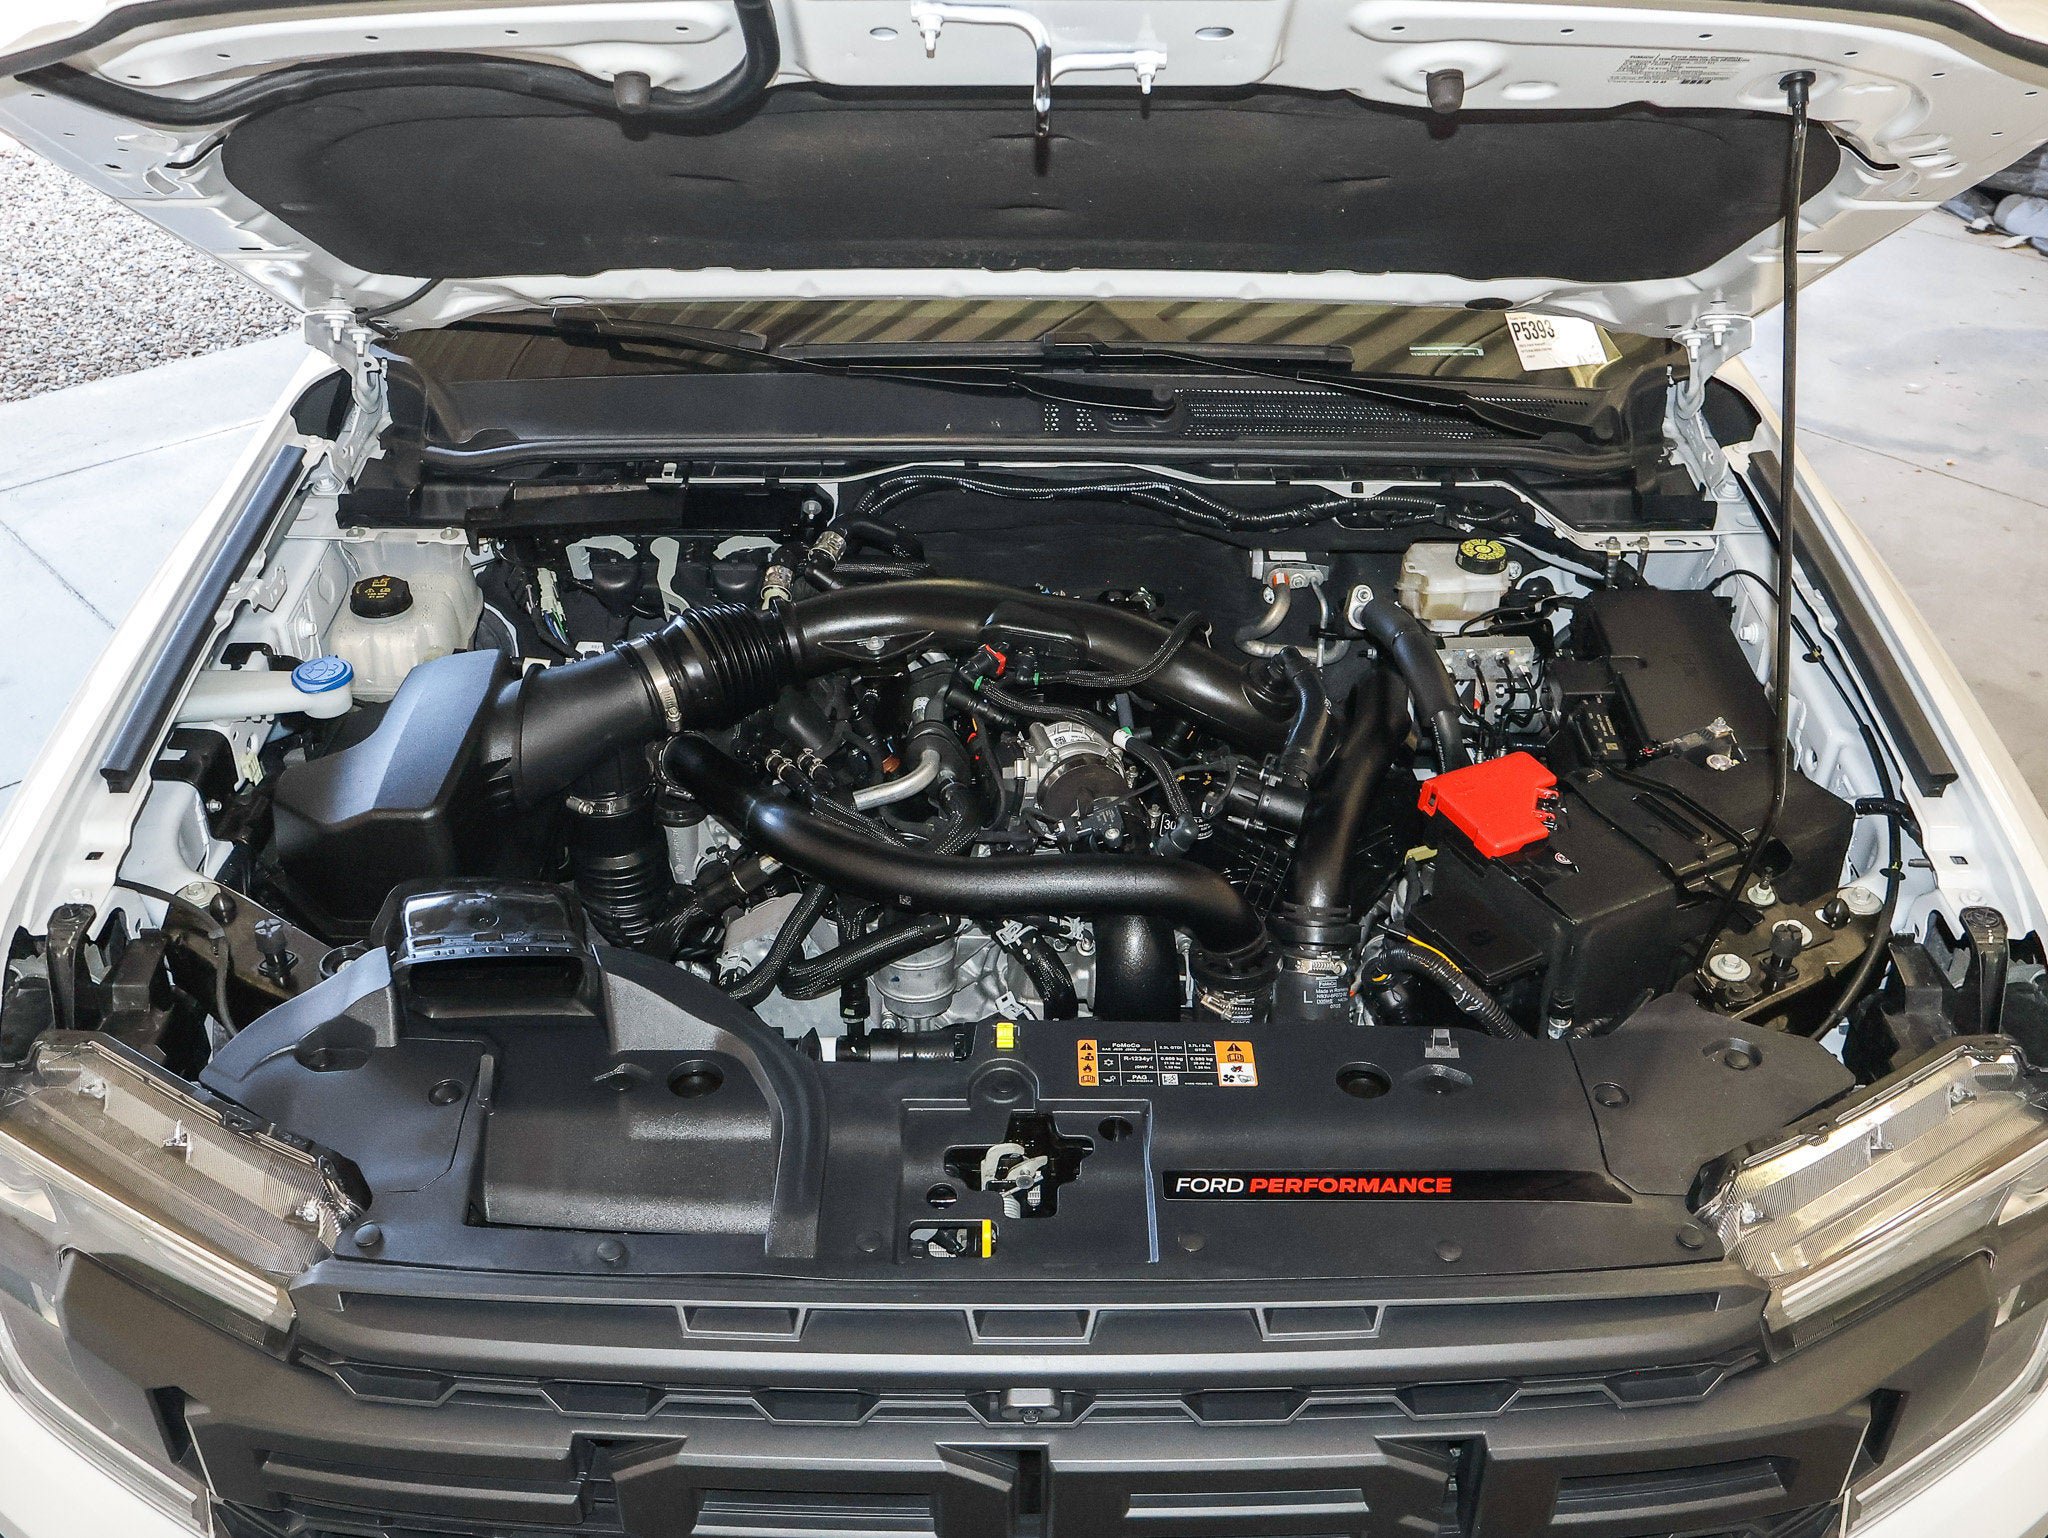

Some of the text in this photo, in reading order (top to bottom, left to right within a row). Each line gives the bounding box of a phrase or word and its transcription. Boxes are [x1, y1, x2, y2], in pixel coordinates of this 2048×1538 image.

[1511, 319, 1555, 341] P5393
[1303, 990, 1313, 1004] L
[1175, 1177, 1452, 1193] FORD PERFORMANCE
